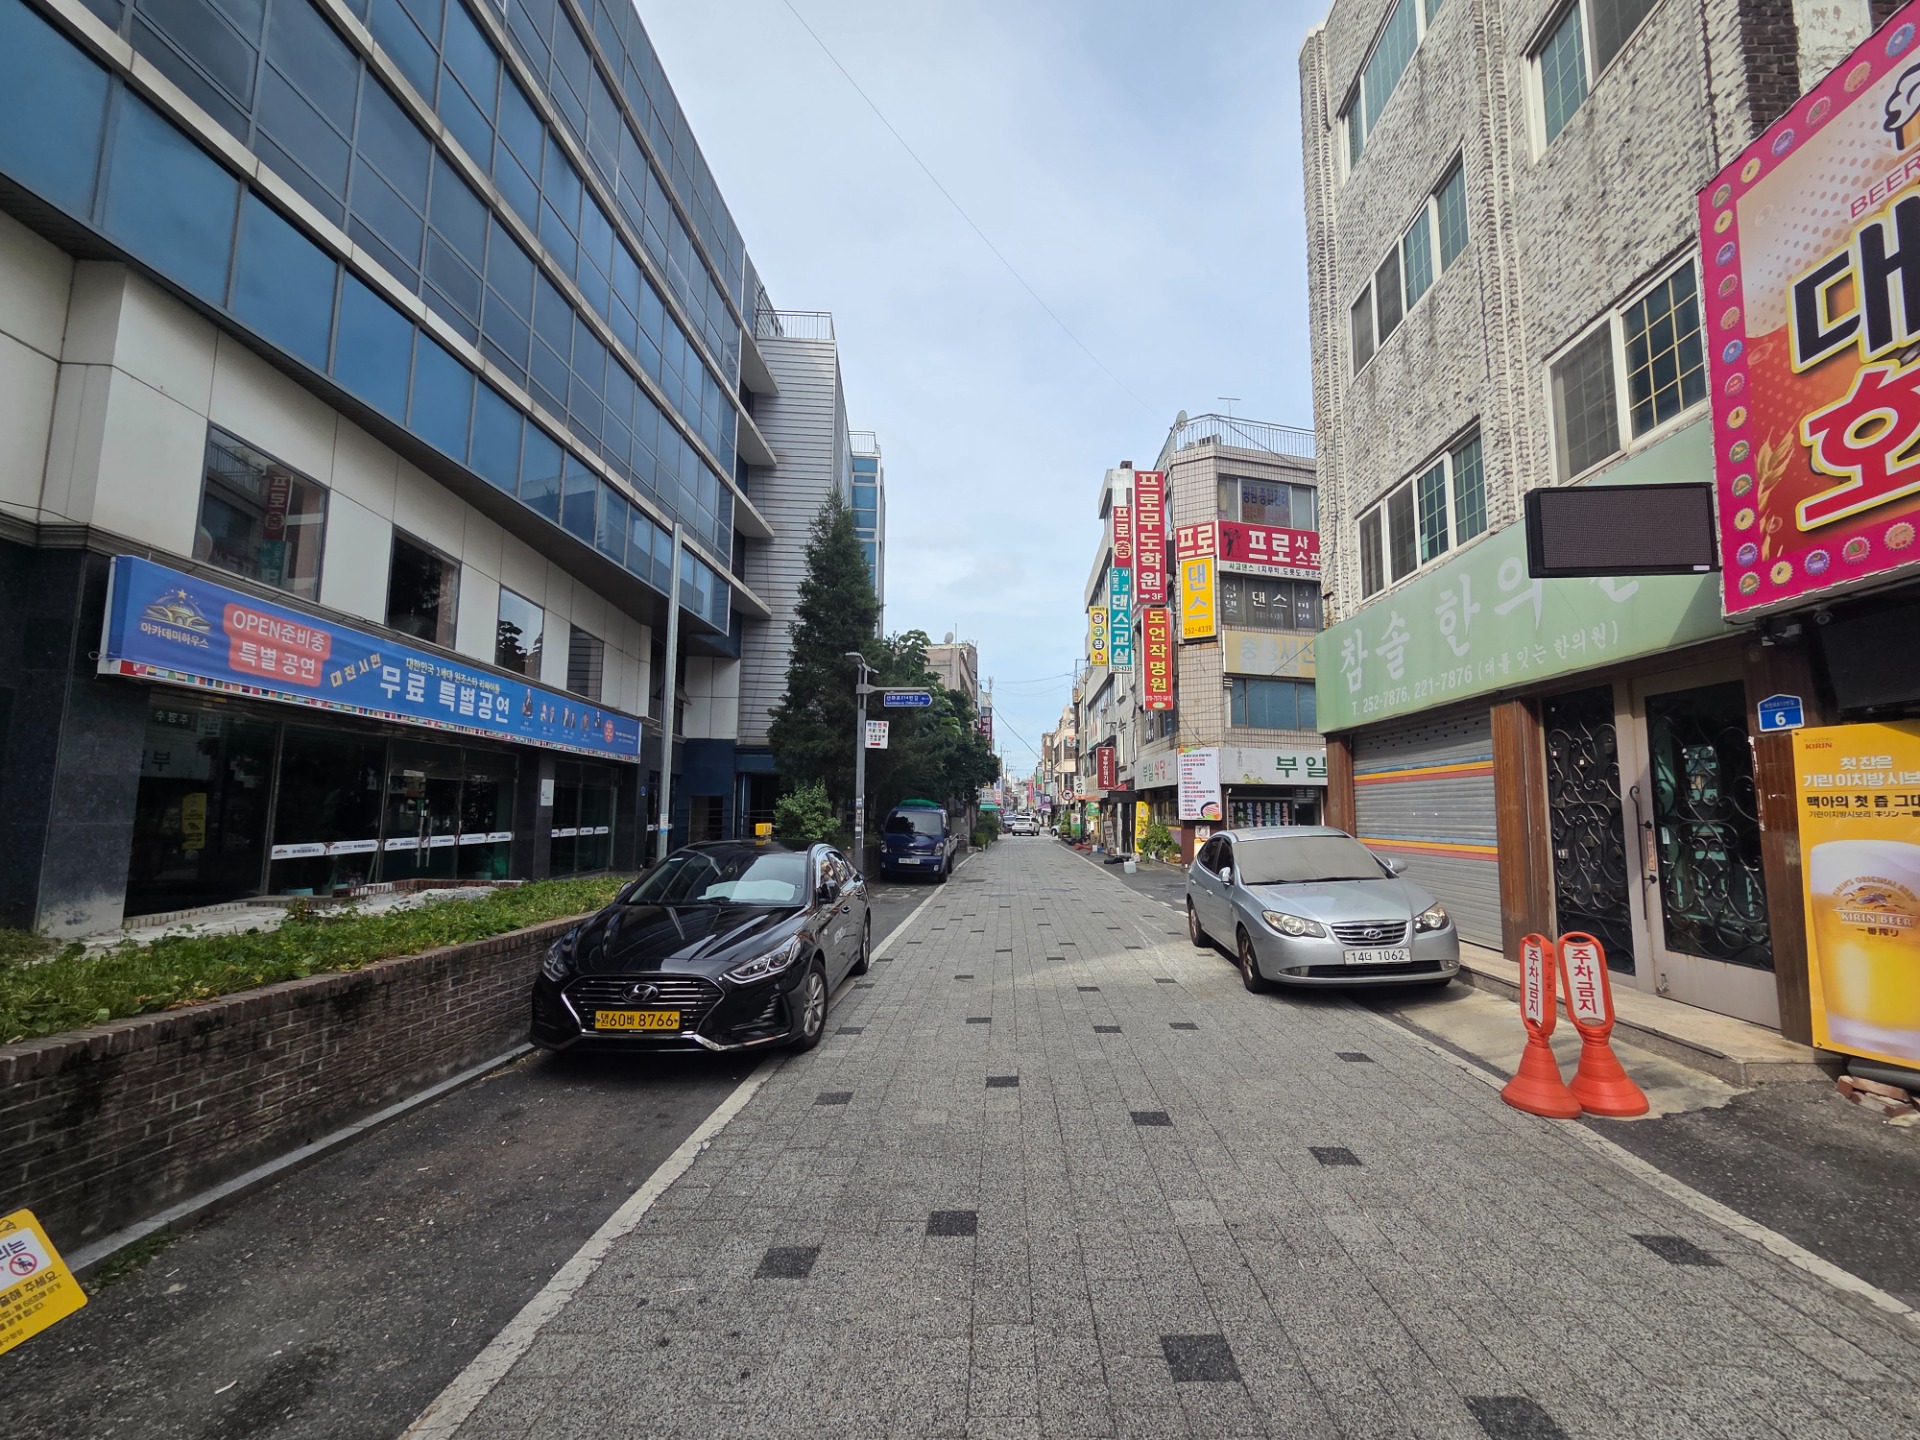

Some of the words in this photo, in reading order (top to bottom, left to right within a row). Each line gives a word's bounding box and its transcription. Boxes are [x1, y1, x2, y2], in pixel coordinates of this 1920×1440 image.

[1114, 507, 1130, 538] 프로
[1138, 473, 1162, 591] 프로무도학원
[1178, 524, 1215, 558] 프로
[1248, 530, 1291, 563] 프로
[1295, 535, 1309, 550] 사
[1151, 592, 1163, 601] 3F
[1187, 563, 1209, 619] 댄스
[1251, 591, 1288, 608] 댄스
[140, 621, 209, 650] 아카데미하우스
[232, 609, 325, 653] OPEN준비중
[1093, 613, 1104, 650] 당구장
[1112, 594, 1130, 664] 댄스교실
[238, 640, 277, 671] 특별
[282, 651, 316, 680] 공연
[405, 657, 434, 676] 대한민국
[1148, 611, 1168, 693] 도언작명원
[1340, 610, 1411, 695] 참솔
[329, 652, 382, 688] 대전시민
[1352, 701, 1361, 718] T.
[1363, 686, 1412, 714] 252-7876,
[1415, 664, 1473, 698] 221-7876
[1555, 620, 1619, 660] 한의원)
[380, 665, 425, 703] 무료
[438, 680, 510, 724] 특별공연
[1775, 711, 1787, 726] 6
[1805, 742, 1833, 750] KIRIN
[1142, 757, 1167, 782] 부일식당
[1275, 755, 1328, 778] 부일
[1840, 756, 1857, 771] 첫
[1859, 754, 1894, 770] 잔은
[1803, 773, 1834, 788] 기린
[1836, 772, 1885, 786] 이치방
[1806, 795, 1849, 809] 맥아의
[1854, 795, 1869, 808] 첫
[1874, 810, 1899, 818] キリン
[1841, 912, 1876, 923] KIRIN
[1880, 915, 1912, 926] BEER
[1377, 949, 1405, 961] 1062
[1528, 949, 1539, 1017] 주차금지
[1572, 948, 1597, 1015] 주차금지
[638, 1013, 674, 1027] 8766
[23, 1270, 62, 1293] 주세요.
